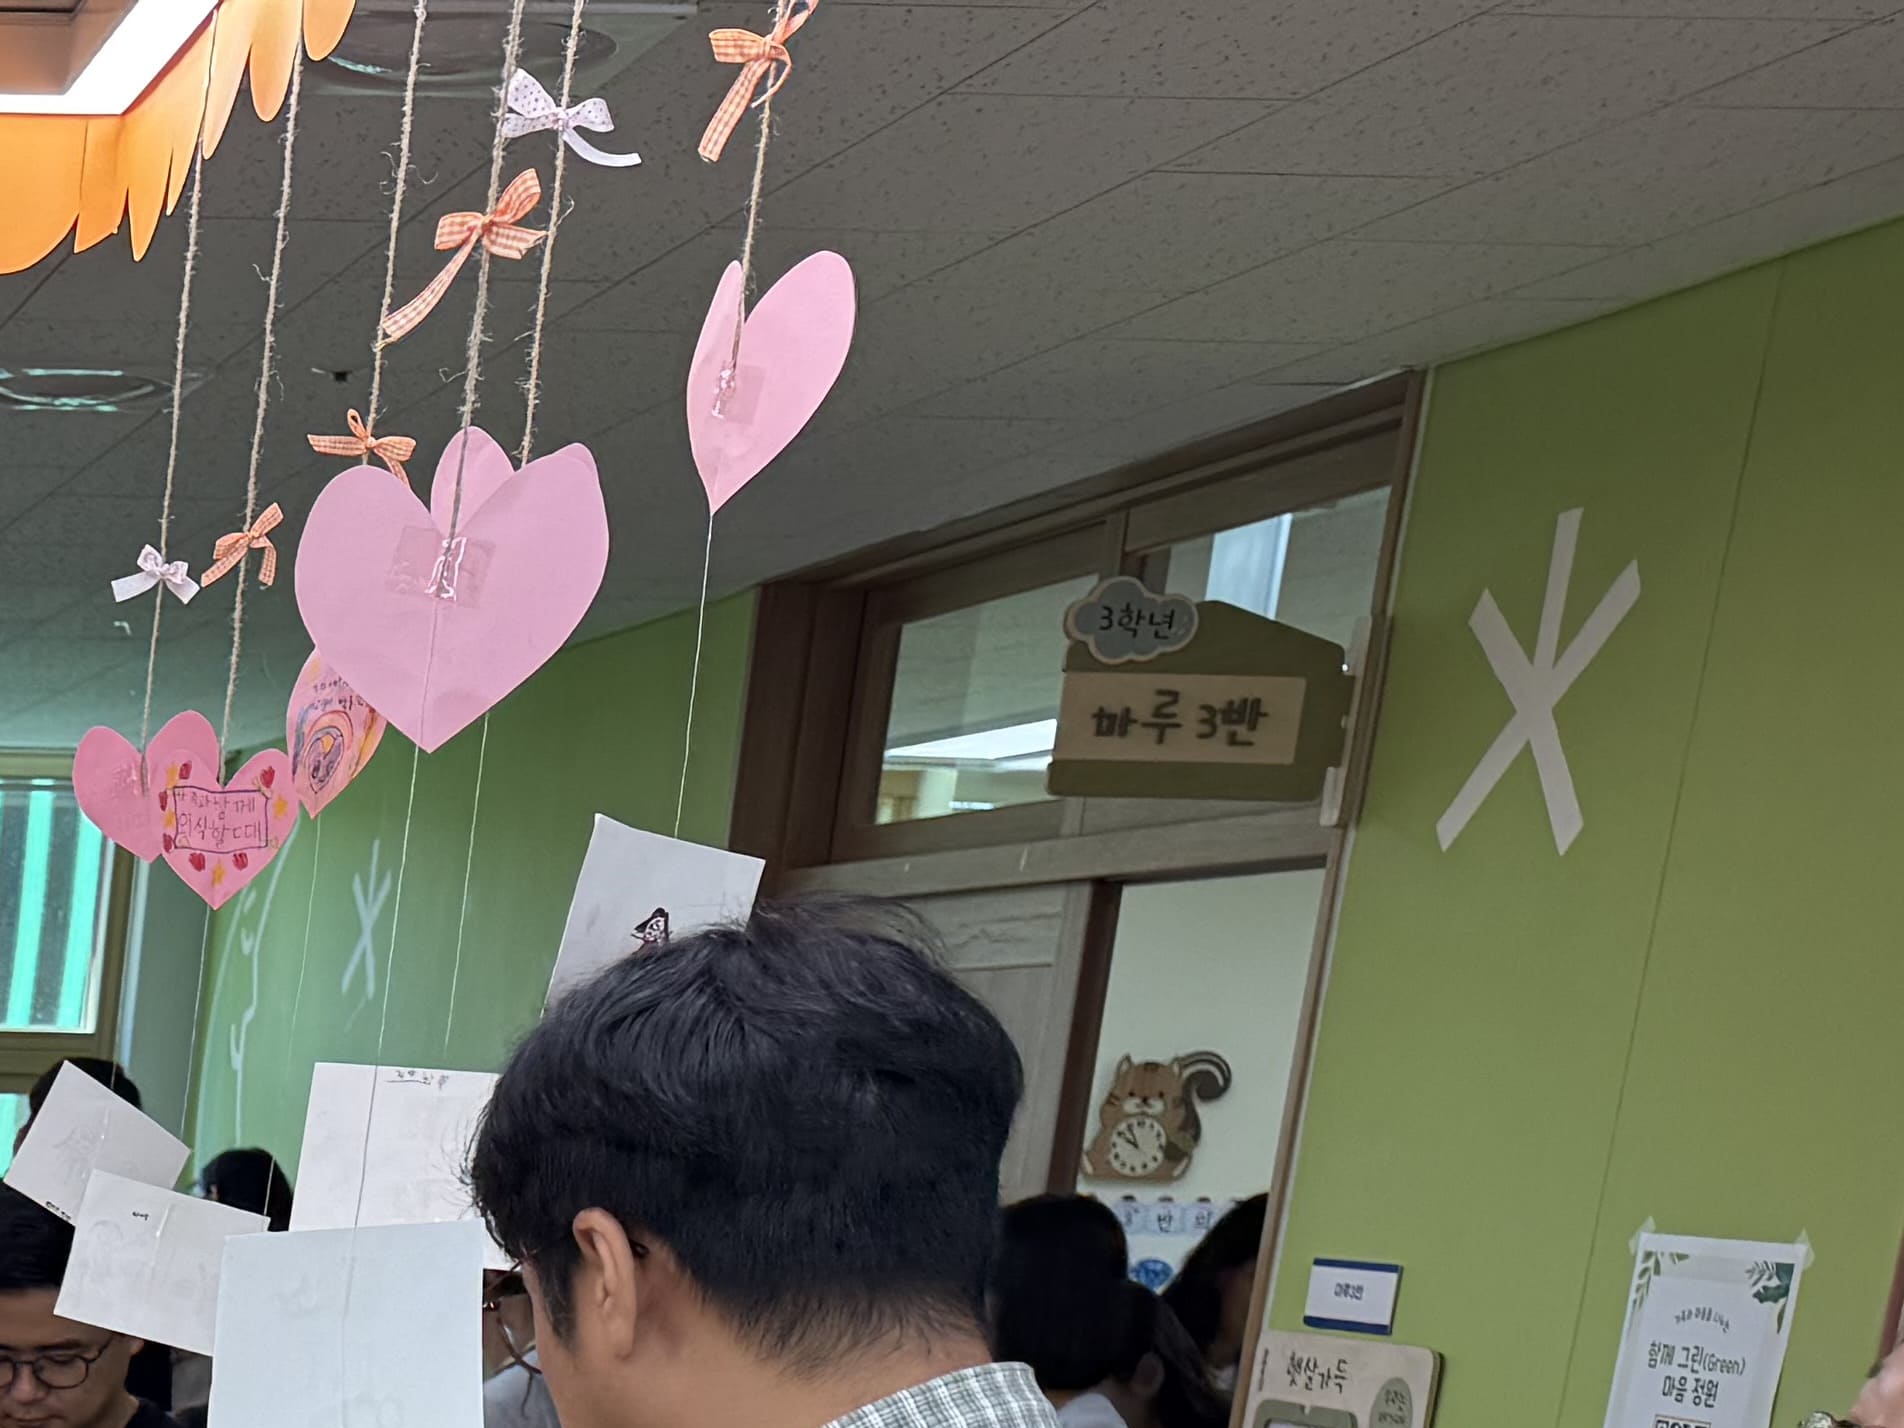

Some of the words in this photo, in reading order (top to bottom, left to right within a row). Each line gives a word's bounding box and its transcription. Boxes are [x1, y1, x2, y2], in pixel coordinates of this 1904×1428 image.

[1098, 602, 1177, 640] 3학년
[1648, 1339, 1676, 1369] 함께
[1677, 1345, 1746, 1377] 그린(Green)
[1662, 1375, 1688, 1404] 마음
[1691, 1377, 1719, 1409] 정원
